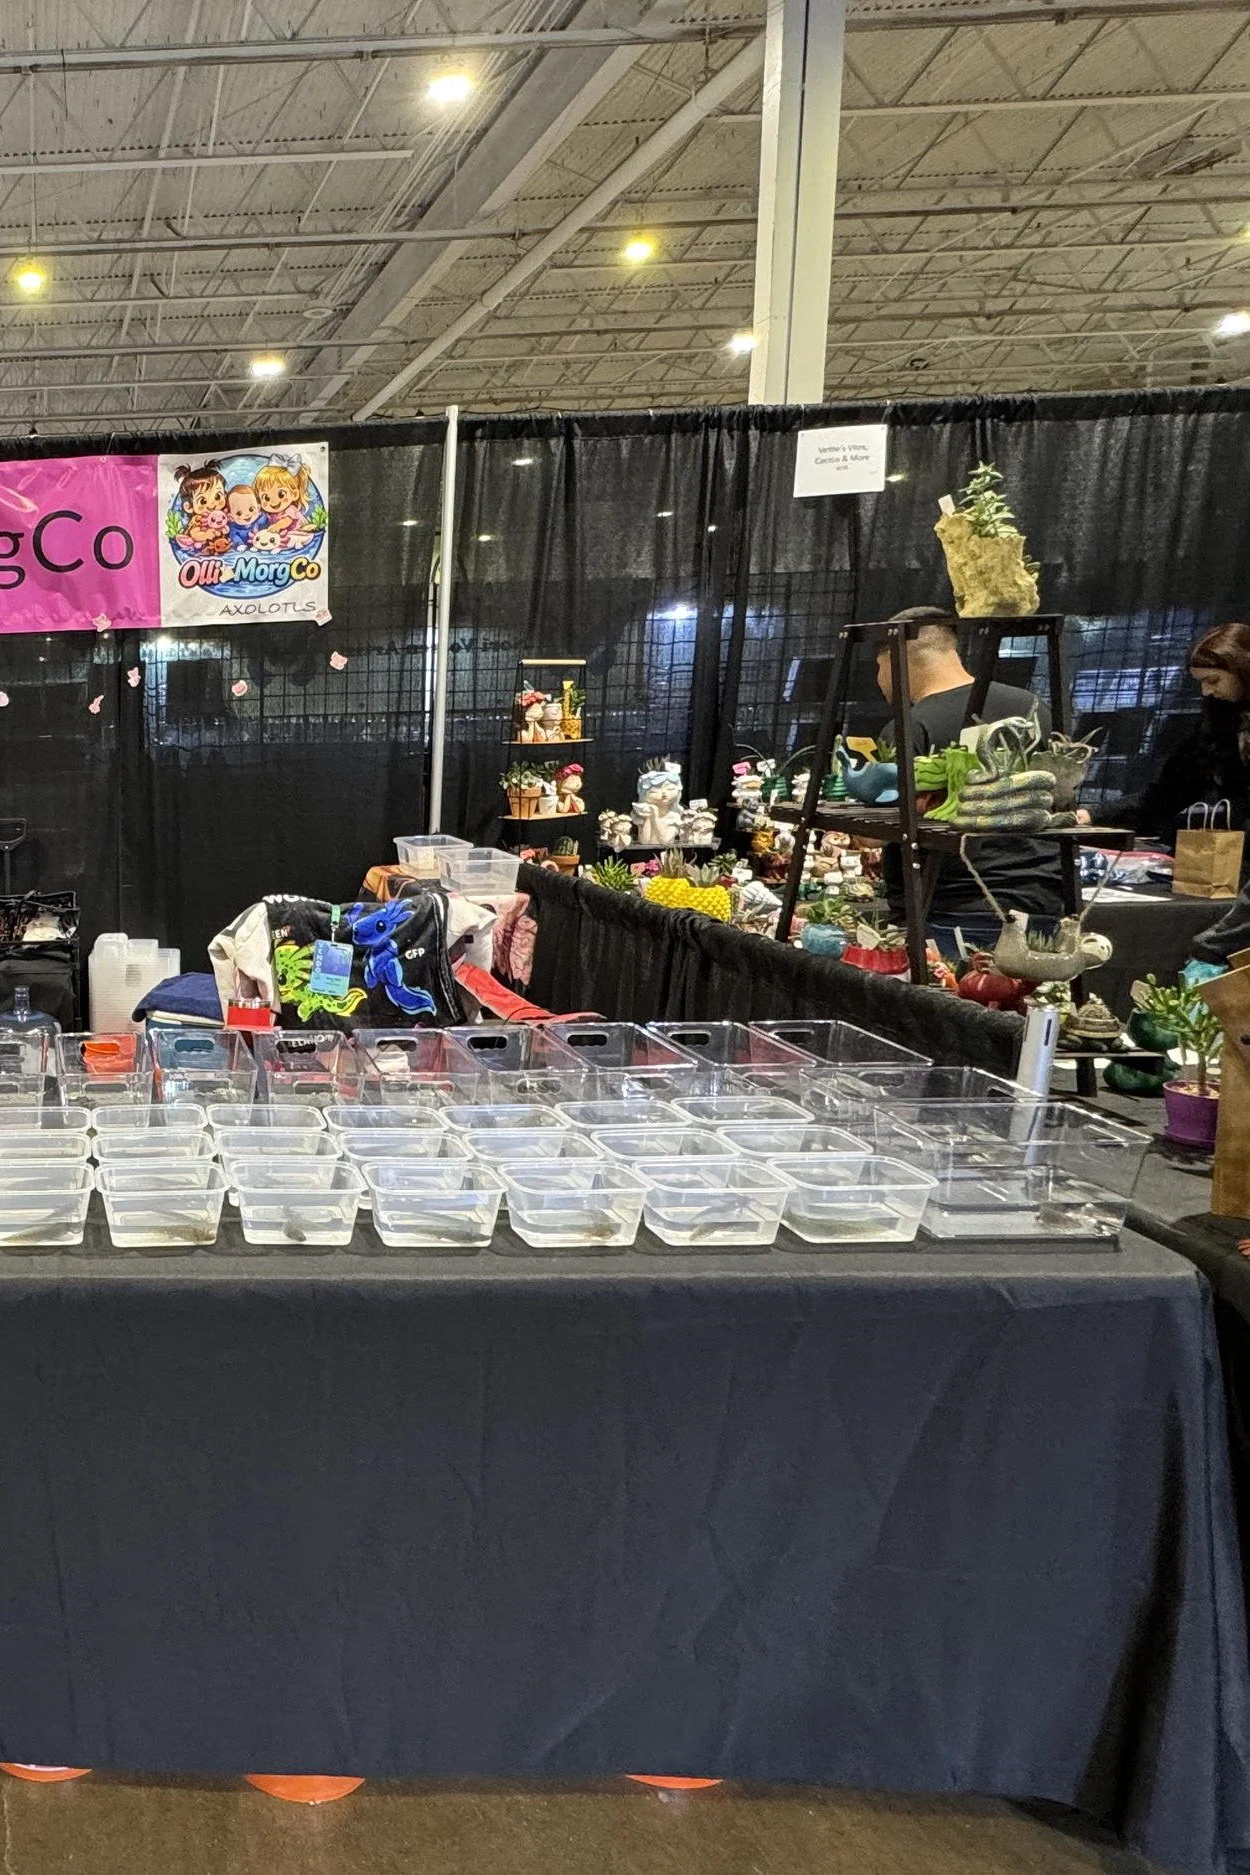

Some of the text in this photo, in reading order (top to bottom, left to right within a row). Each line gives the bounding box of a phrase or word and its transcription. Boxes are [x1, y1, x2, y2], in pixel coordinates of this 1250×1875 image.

[178, 556, 322, 589] Olli MorgCo
[218, 601, 316, 617] AXOLOTLS
[405, 947, 425, 960] GFP
